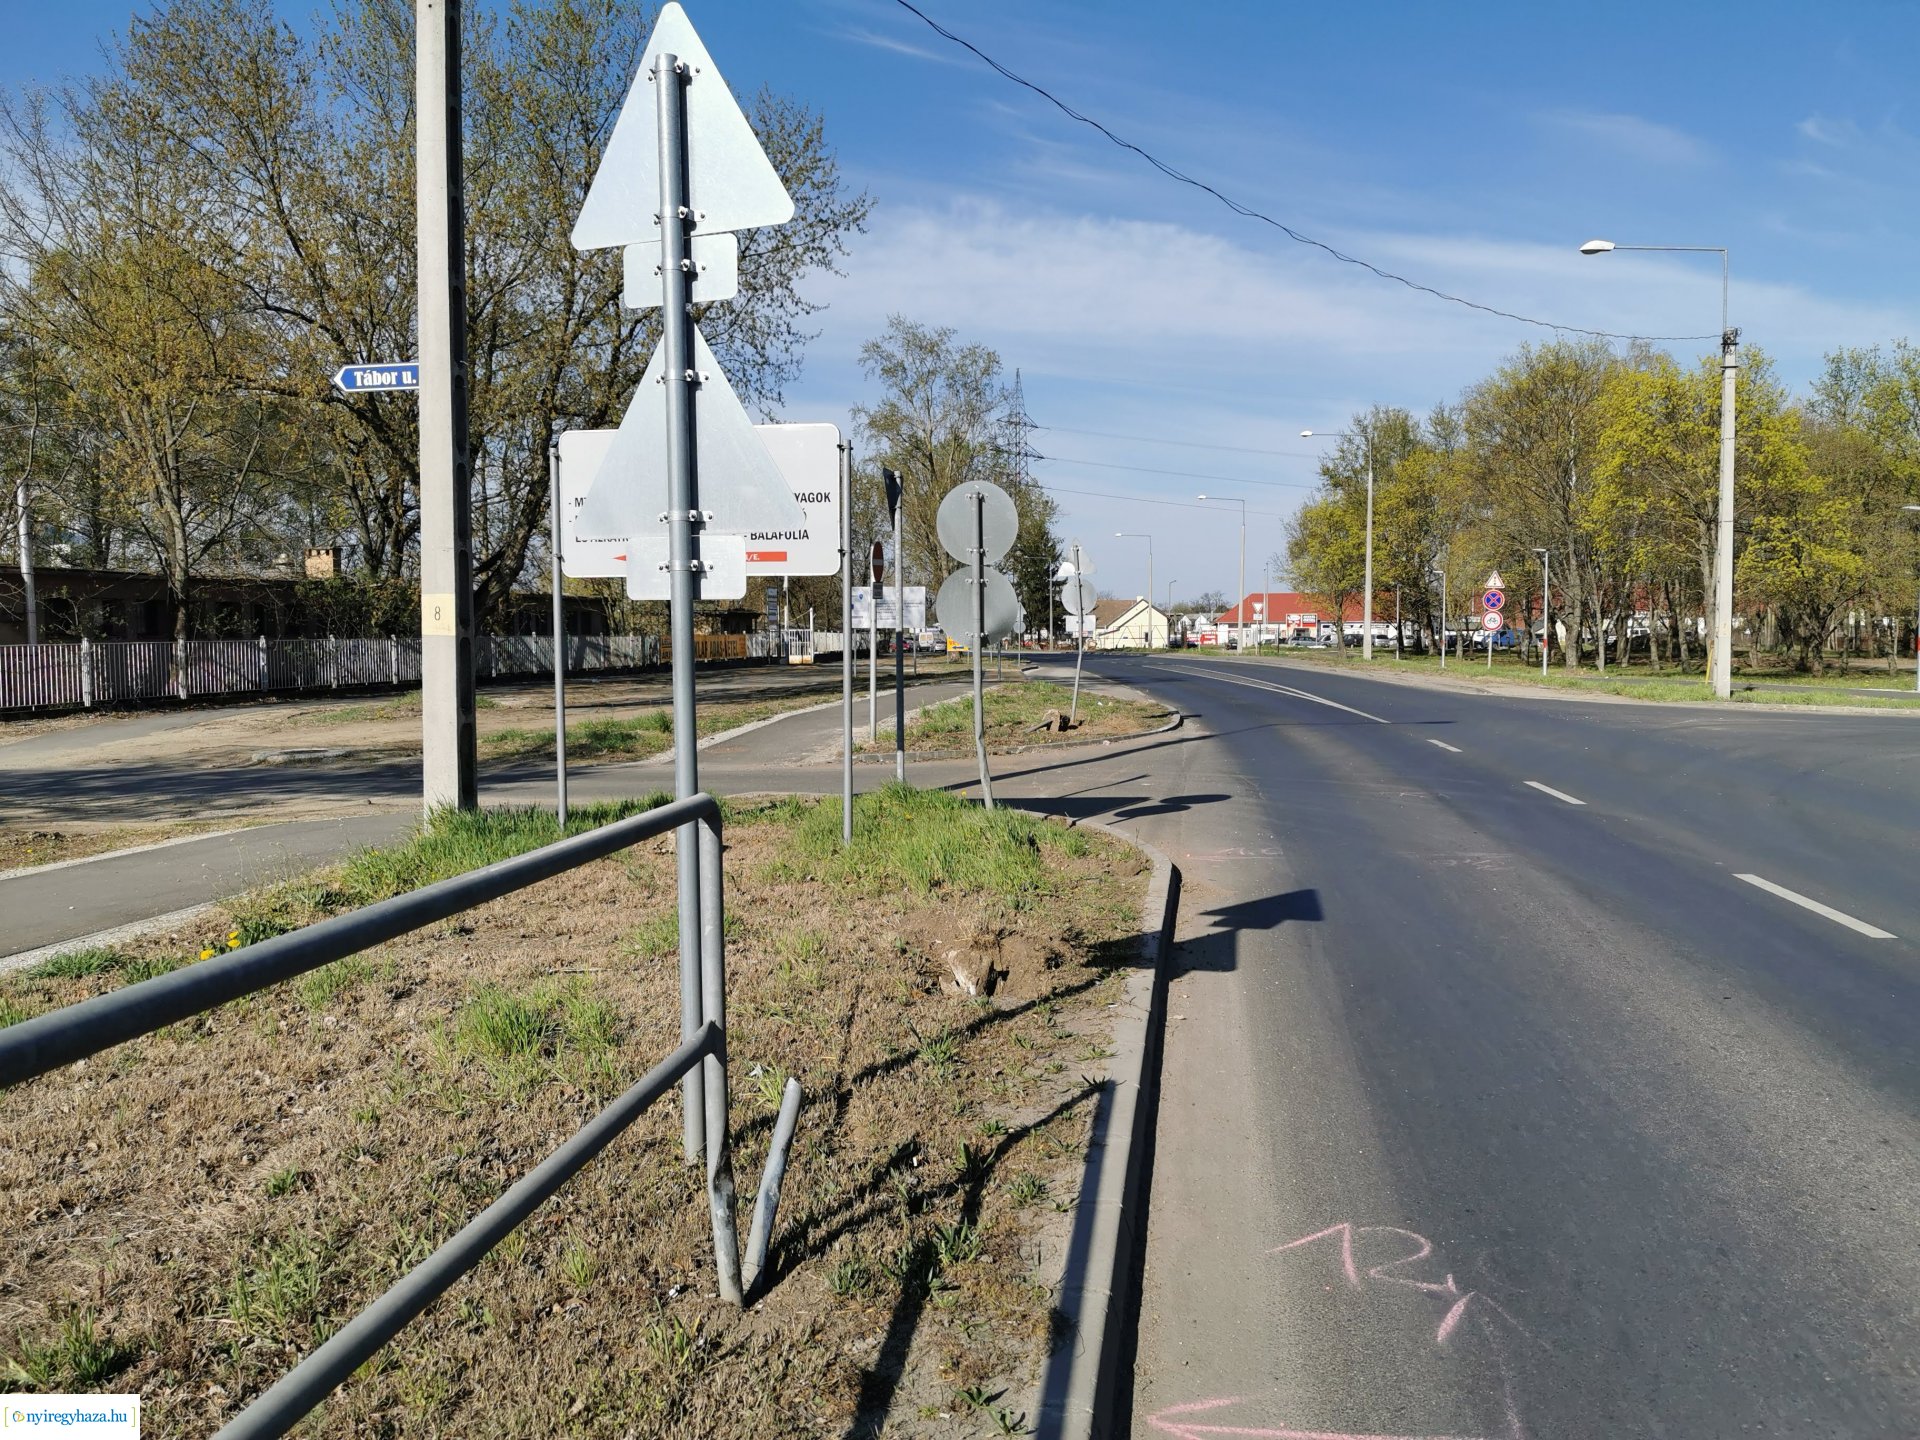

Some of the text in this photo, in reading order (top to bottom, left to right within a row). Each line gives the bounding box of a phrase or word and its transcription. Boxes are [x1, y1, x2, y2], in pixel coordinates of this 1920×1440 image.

[353, 369, 417, 387] Tábor u.
[794, 491, 832, 503] YAGOK
[434, 605, 441, 621] 8
